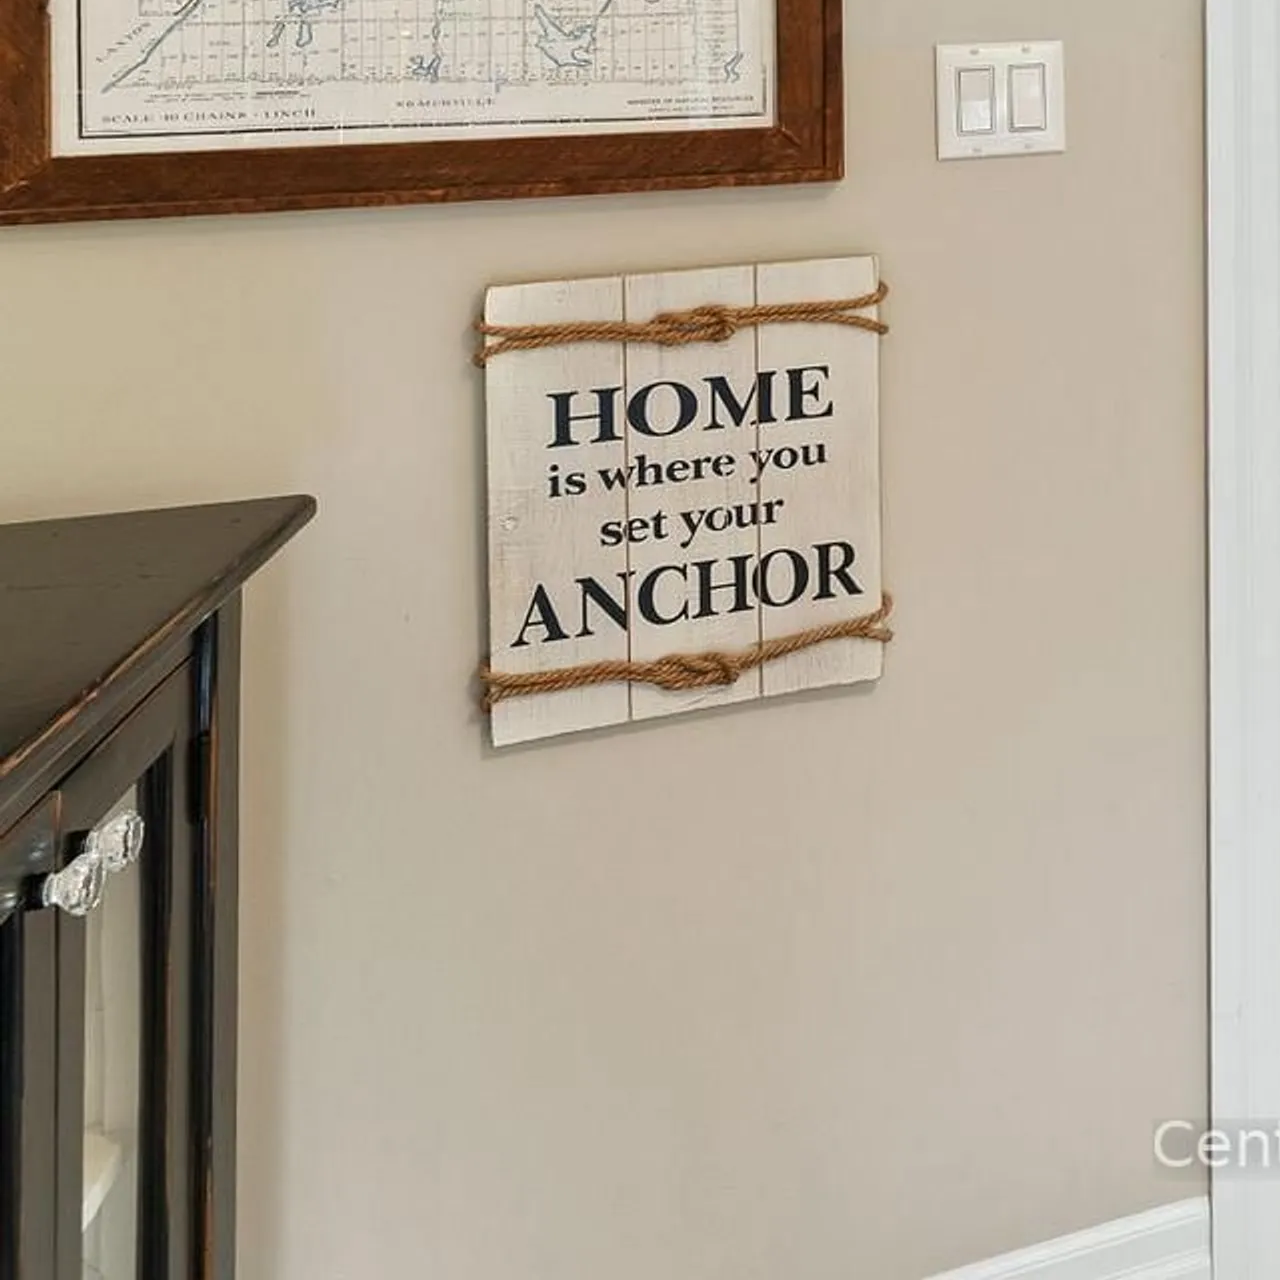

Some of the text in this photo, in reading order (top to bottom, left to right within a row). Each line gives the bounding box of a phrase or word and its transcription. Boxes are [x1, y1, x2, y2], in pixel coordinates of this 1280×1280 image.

[546, 365, 834, 449] HOME
[548, 442, 828, 498] is where you
[600, 498, 785, 548] set your
[510, 540, 864, 648] ANCHOR
